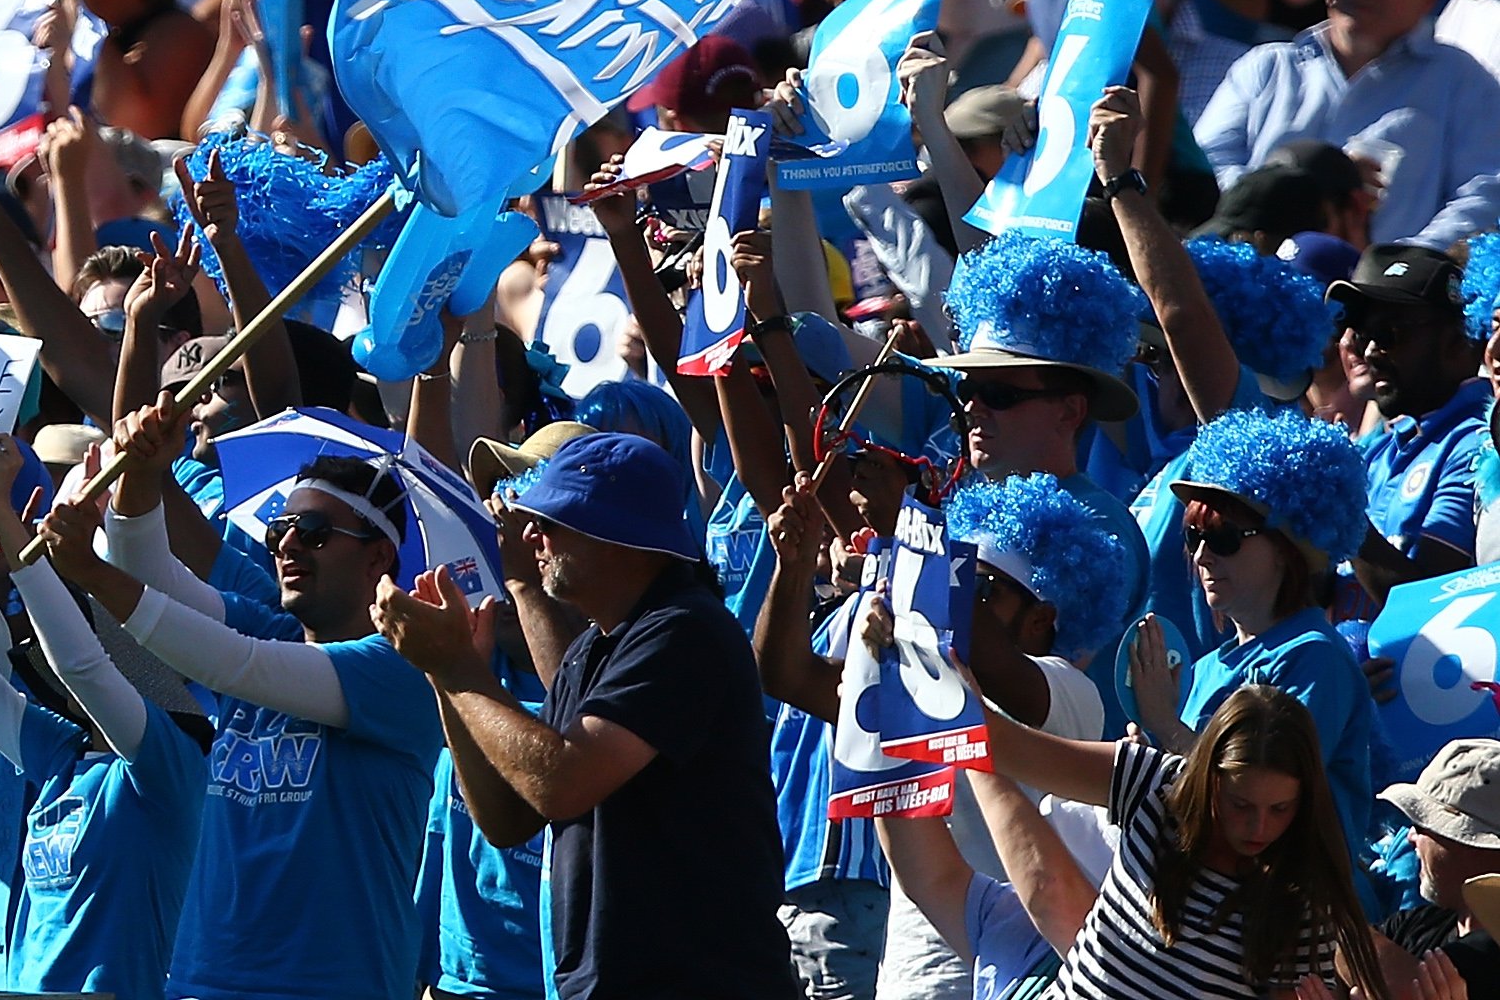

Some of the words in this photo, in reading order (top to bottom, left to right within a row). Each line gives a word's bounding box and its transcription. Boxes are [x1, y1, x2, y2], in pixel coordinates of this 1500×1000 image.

[782, 168, 821, 180] THANK
[823, 166, 840, 179] YOU
[542, 237, 631, 400] 6
[1400, 591, 1497, 725] 6
[852, 789, 875, 806] MUST
[876, 786, 900, 800] HAVE
[900, 781, 919, 795] HAD
[873, 801, 893, 815] HIS
[895, 783, 950, 811] WEET-BIX
[513, 850, 542, 867] GROU
